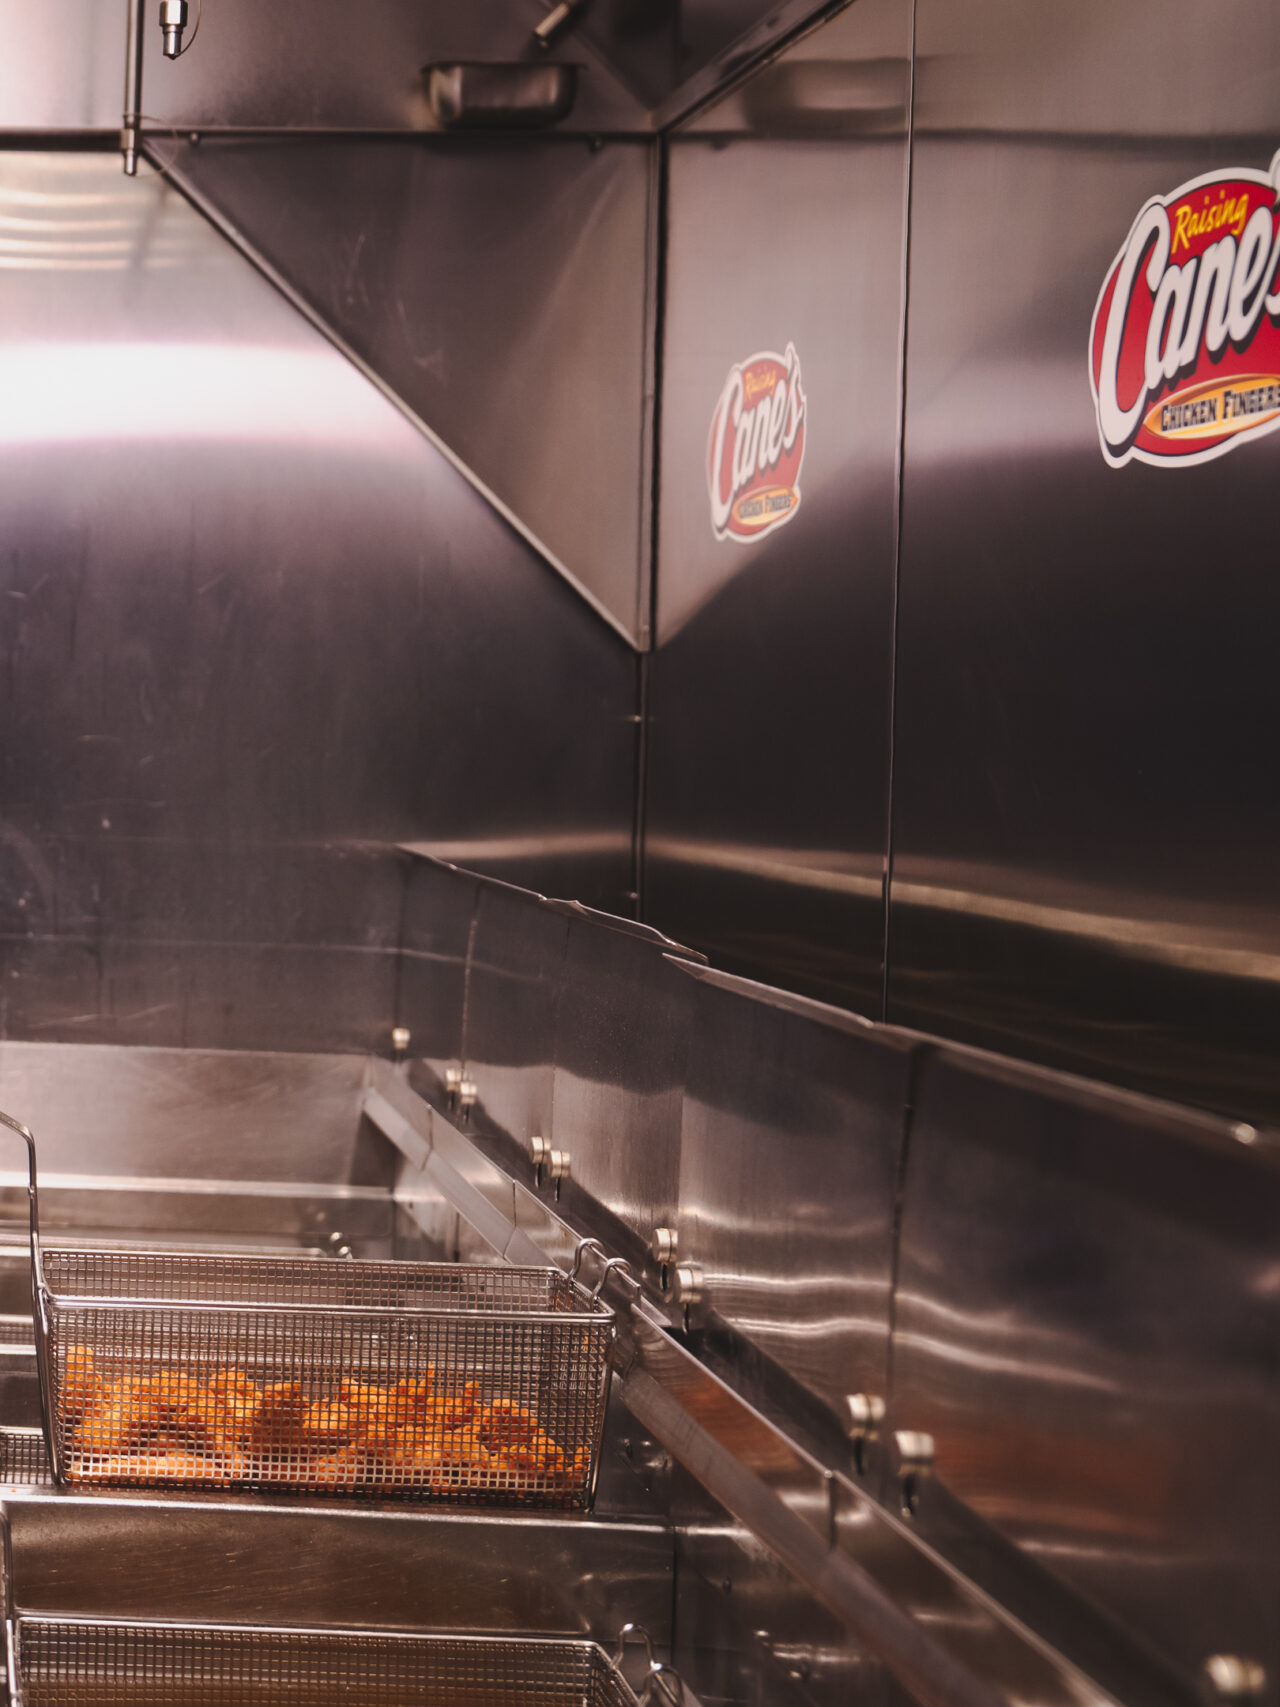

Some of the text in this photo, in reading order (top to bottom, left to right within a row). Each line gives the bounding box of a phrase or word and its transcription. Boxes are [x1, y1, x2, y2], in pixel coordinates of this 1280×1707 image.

[1171, 189, 1250, 254] Raising
[1098, 152, 1280, 448] Cane'
[712, 348, 806, 528] Cane's
[1161, 397, 1218, 432] CHICKEN
